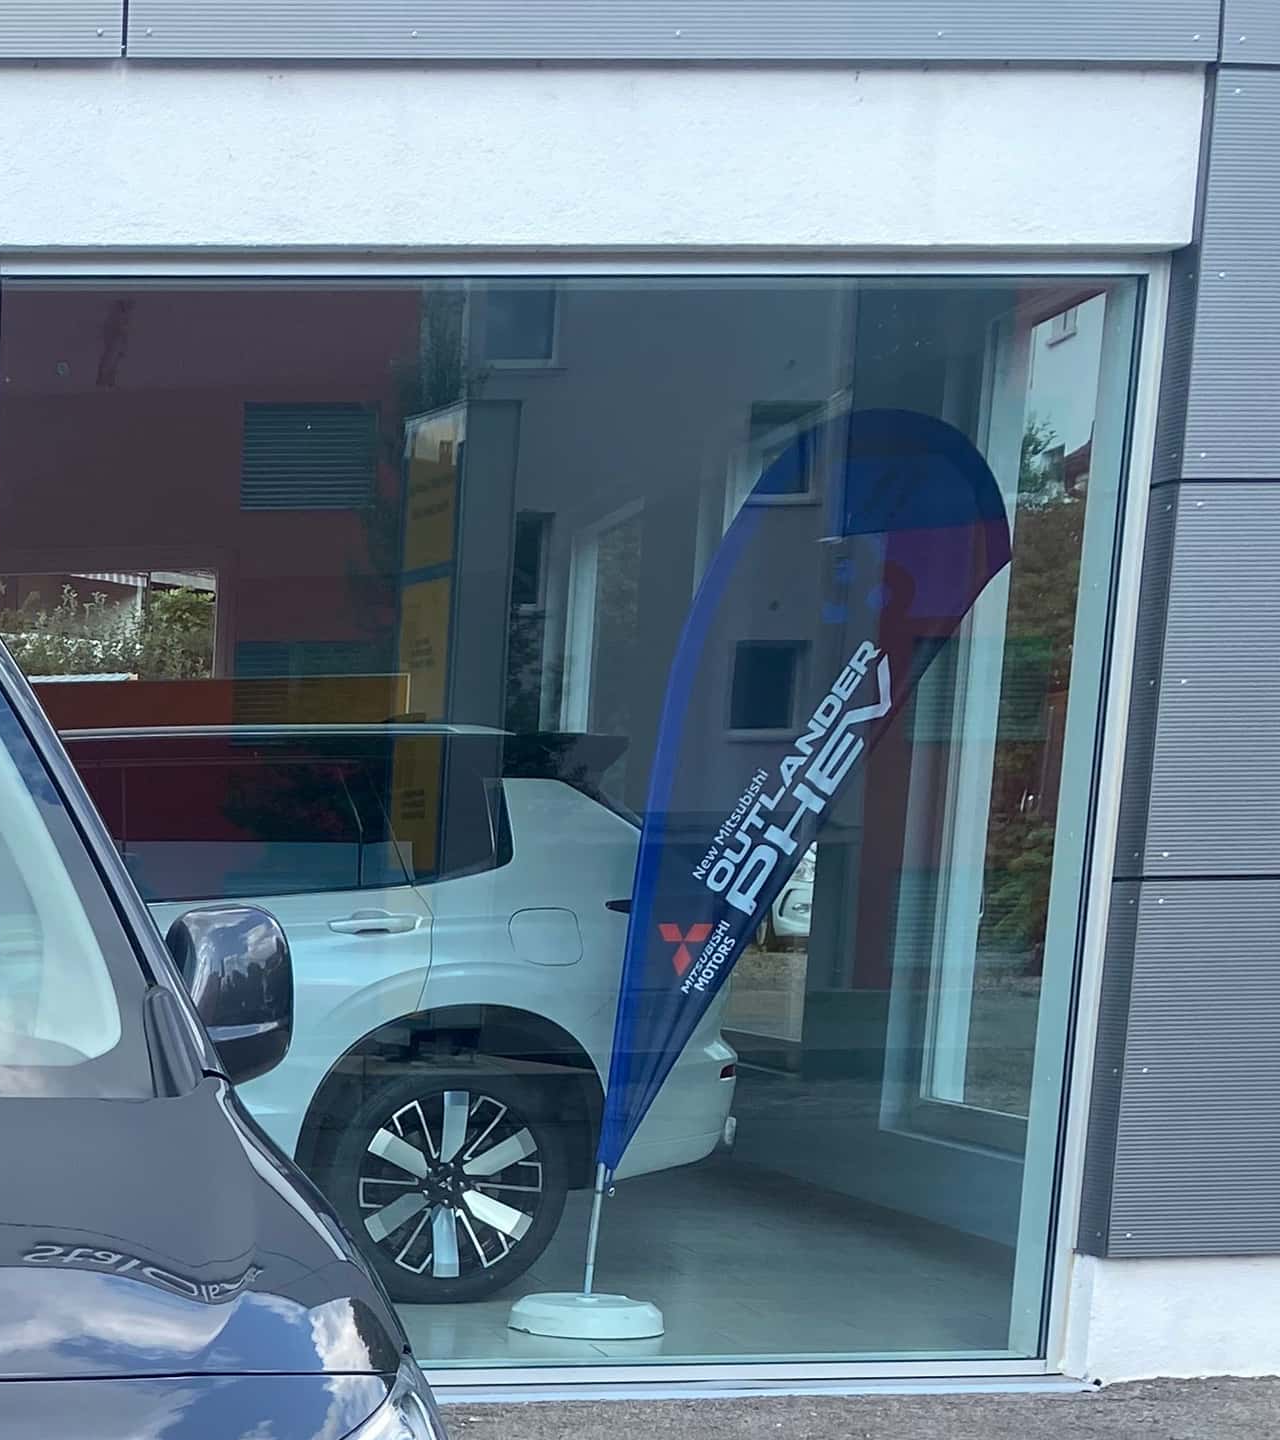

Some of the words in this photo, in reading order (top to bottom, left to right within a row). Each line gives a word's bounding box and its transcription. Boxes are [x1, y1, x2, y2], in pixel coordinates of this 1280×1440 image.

[706, 640, 883, 893] OUTLANDER
[725, 653, 893, 917] PHEV
[692, 846, 719, 880] New
[713, 768, 769, 847] Mitsubishi
[680, 919, 731, 994] MITSUBISHI
[694, 935, 736, 992] MOTORS
